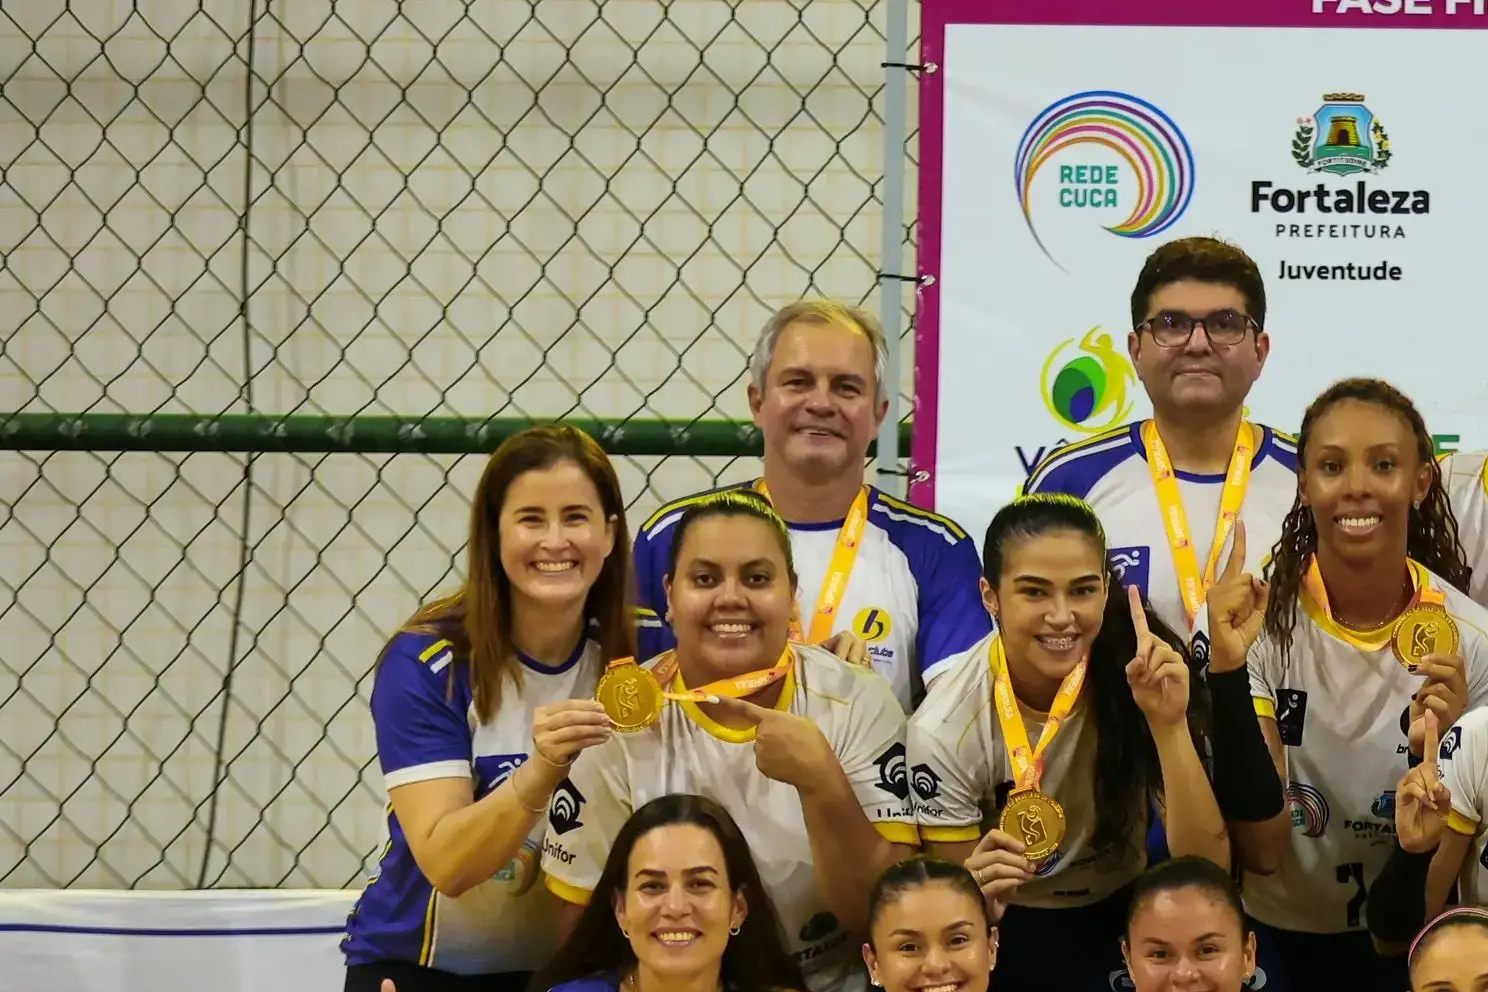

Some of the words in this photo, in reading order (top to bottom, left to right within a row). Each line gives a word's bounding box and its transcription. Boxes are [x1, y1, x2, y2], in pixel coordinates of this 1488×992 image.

[1060, 165, 1118, 184] REDE
[1060, 188, 1118, 207] CUCA
[1251, 181, 1430, 214] Fortaleza
[1275, 224, 1405, 238] PREFEITURA
[1278, 260, 1402, 280] Juventude
[541, 837, 577, 865] Unifor
